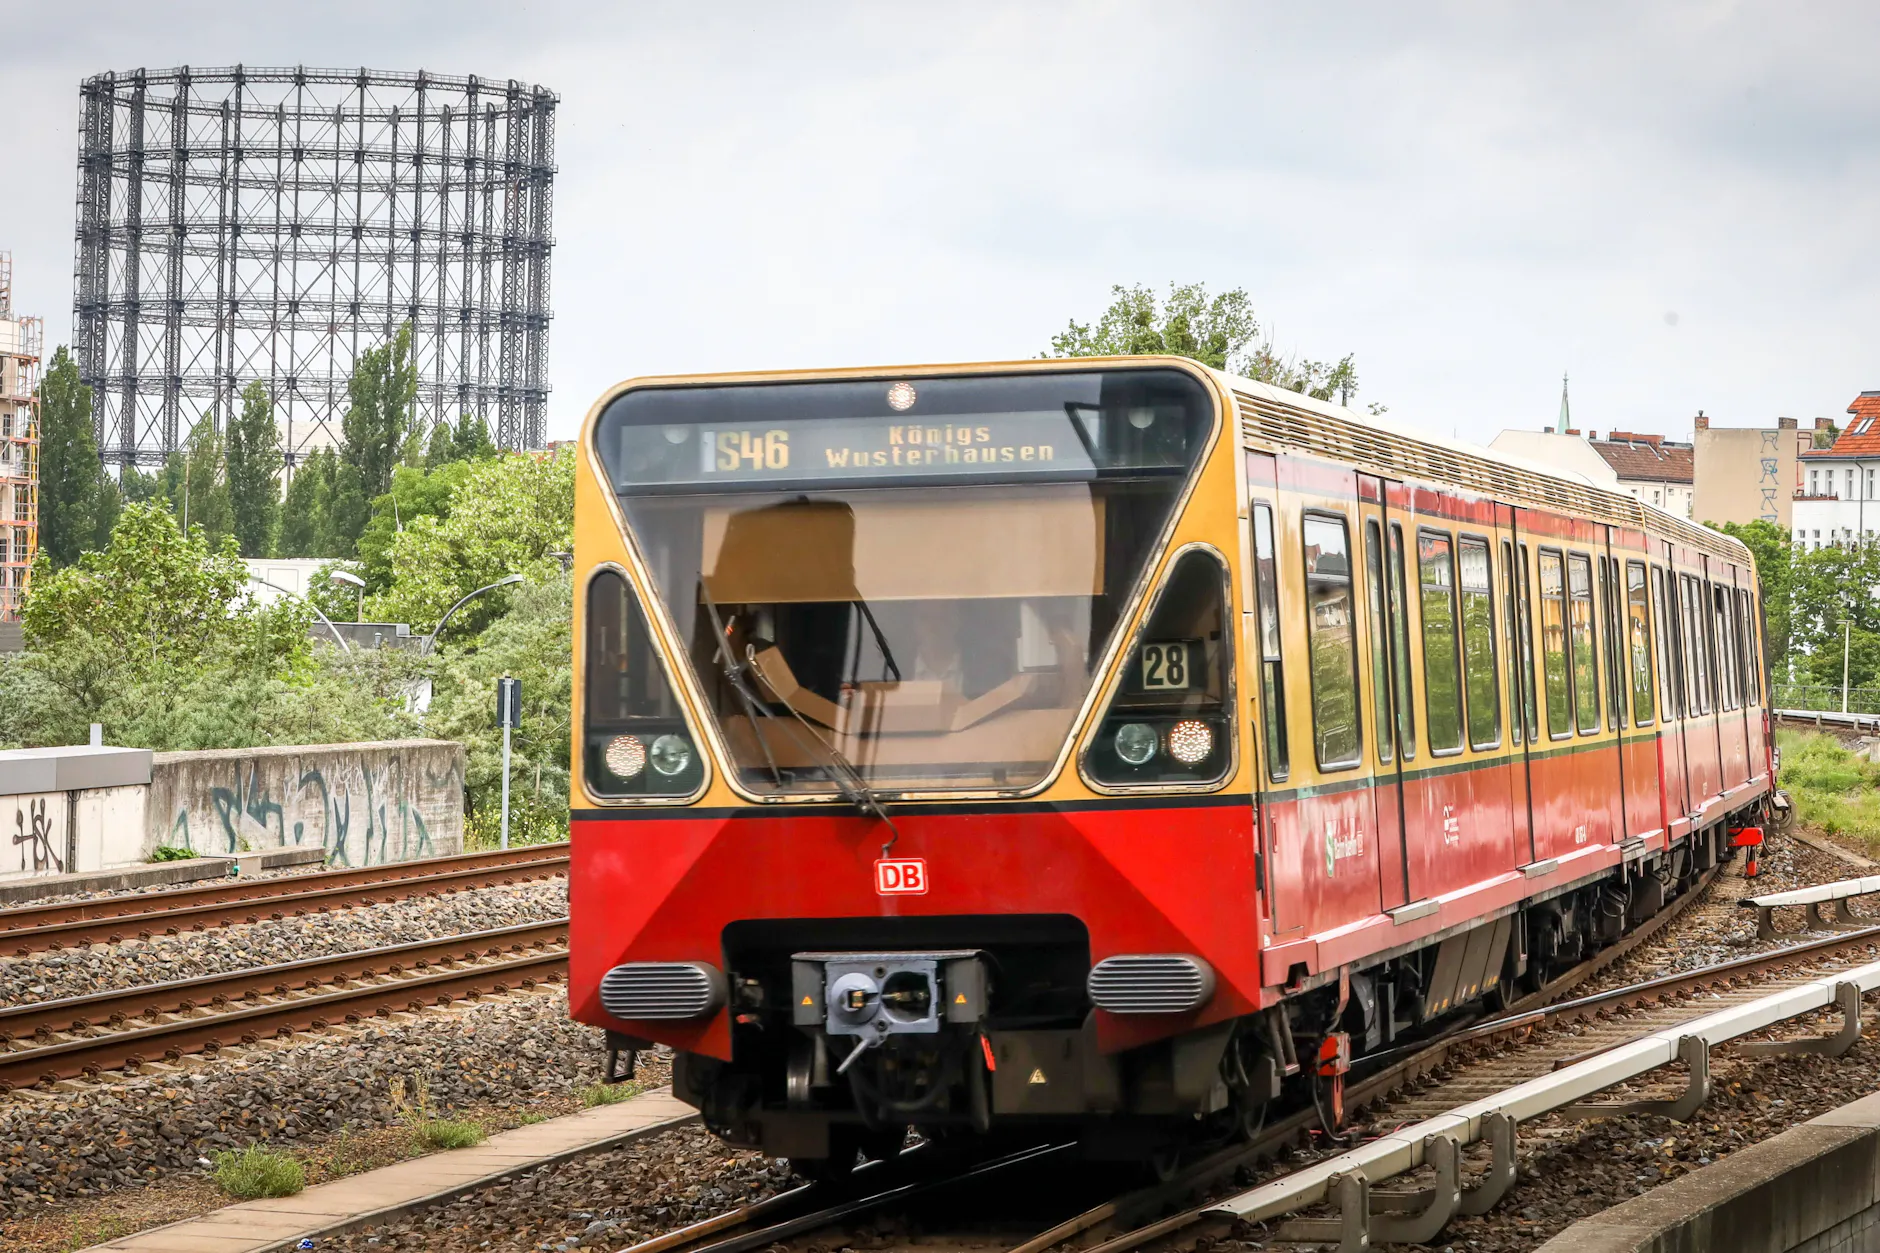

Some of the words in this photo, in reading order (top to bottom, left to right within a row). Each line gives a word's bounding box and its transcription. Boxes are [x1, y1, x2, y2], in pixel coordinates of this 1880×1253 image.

[889, 424, 990, 446] Königs
[717, 430, 789, 471] S46
[825, 445, 1054, 468] Wusterhausen
[1145, 645, 1184, 686] 28
[881, 864, 921, 889] DB
